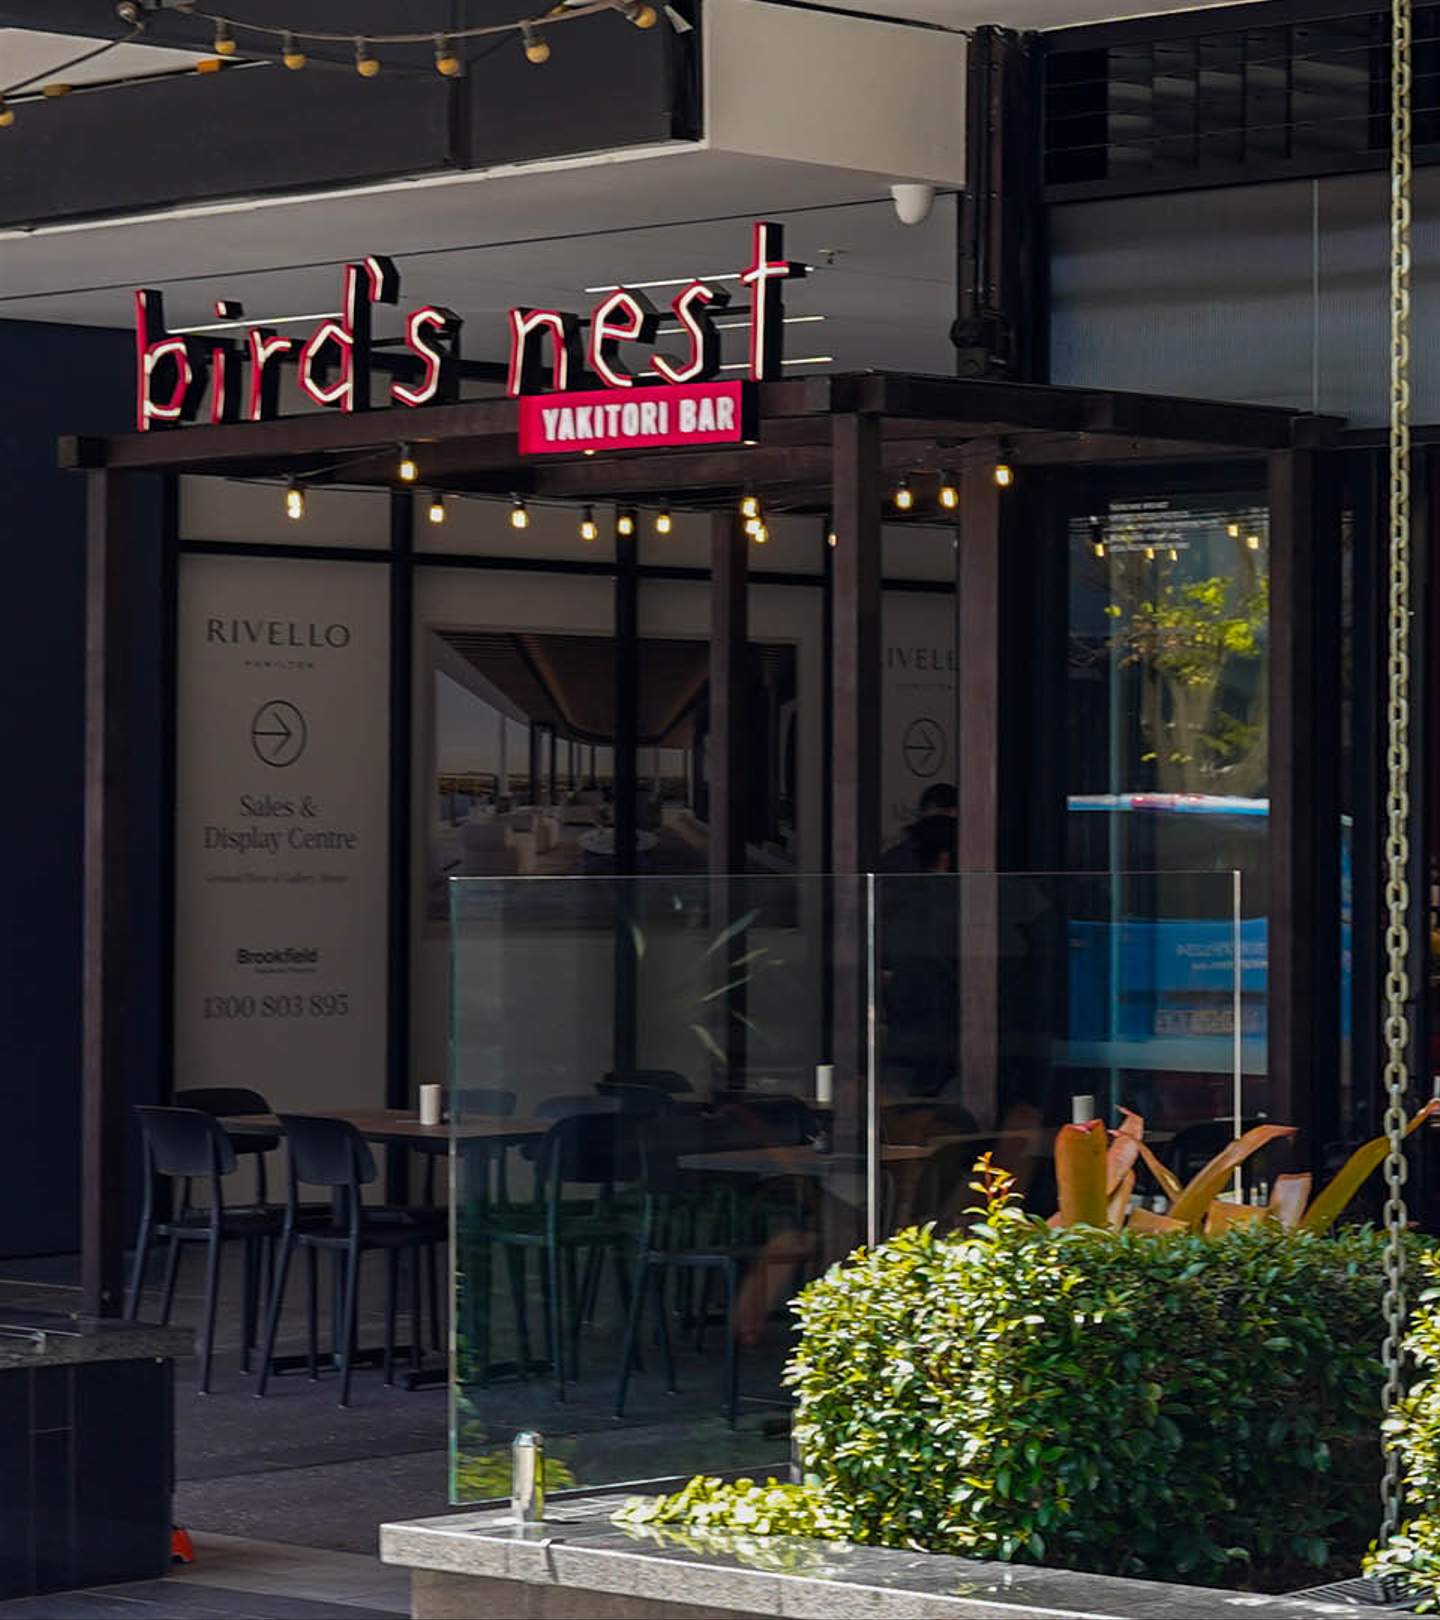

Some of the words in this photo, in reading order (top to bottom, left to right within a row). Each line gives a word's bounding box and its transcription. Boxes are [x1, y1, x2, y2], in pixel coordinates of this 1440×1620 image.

[136, 254, 460, 432] bird's
[507, 222, 788, 396] nest
[541, 401, 669, 441] YAKITORI
[679, 396, 735, 433] BAR
[206, 618, 351, 648] RIVELLO
[239, 793, 296, 817] Sales
[300, 793, 319, 818] &
[203, 825, 280, 855] Display
[287, 826, 359, 850] Centre
[236, 947, 319, 965] Brookfield
[203, 994, 256, 1019] 1300
[261, 994, 304, 1018] 803
[309, 993, 349, 1017] 895
